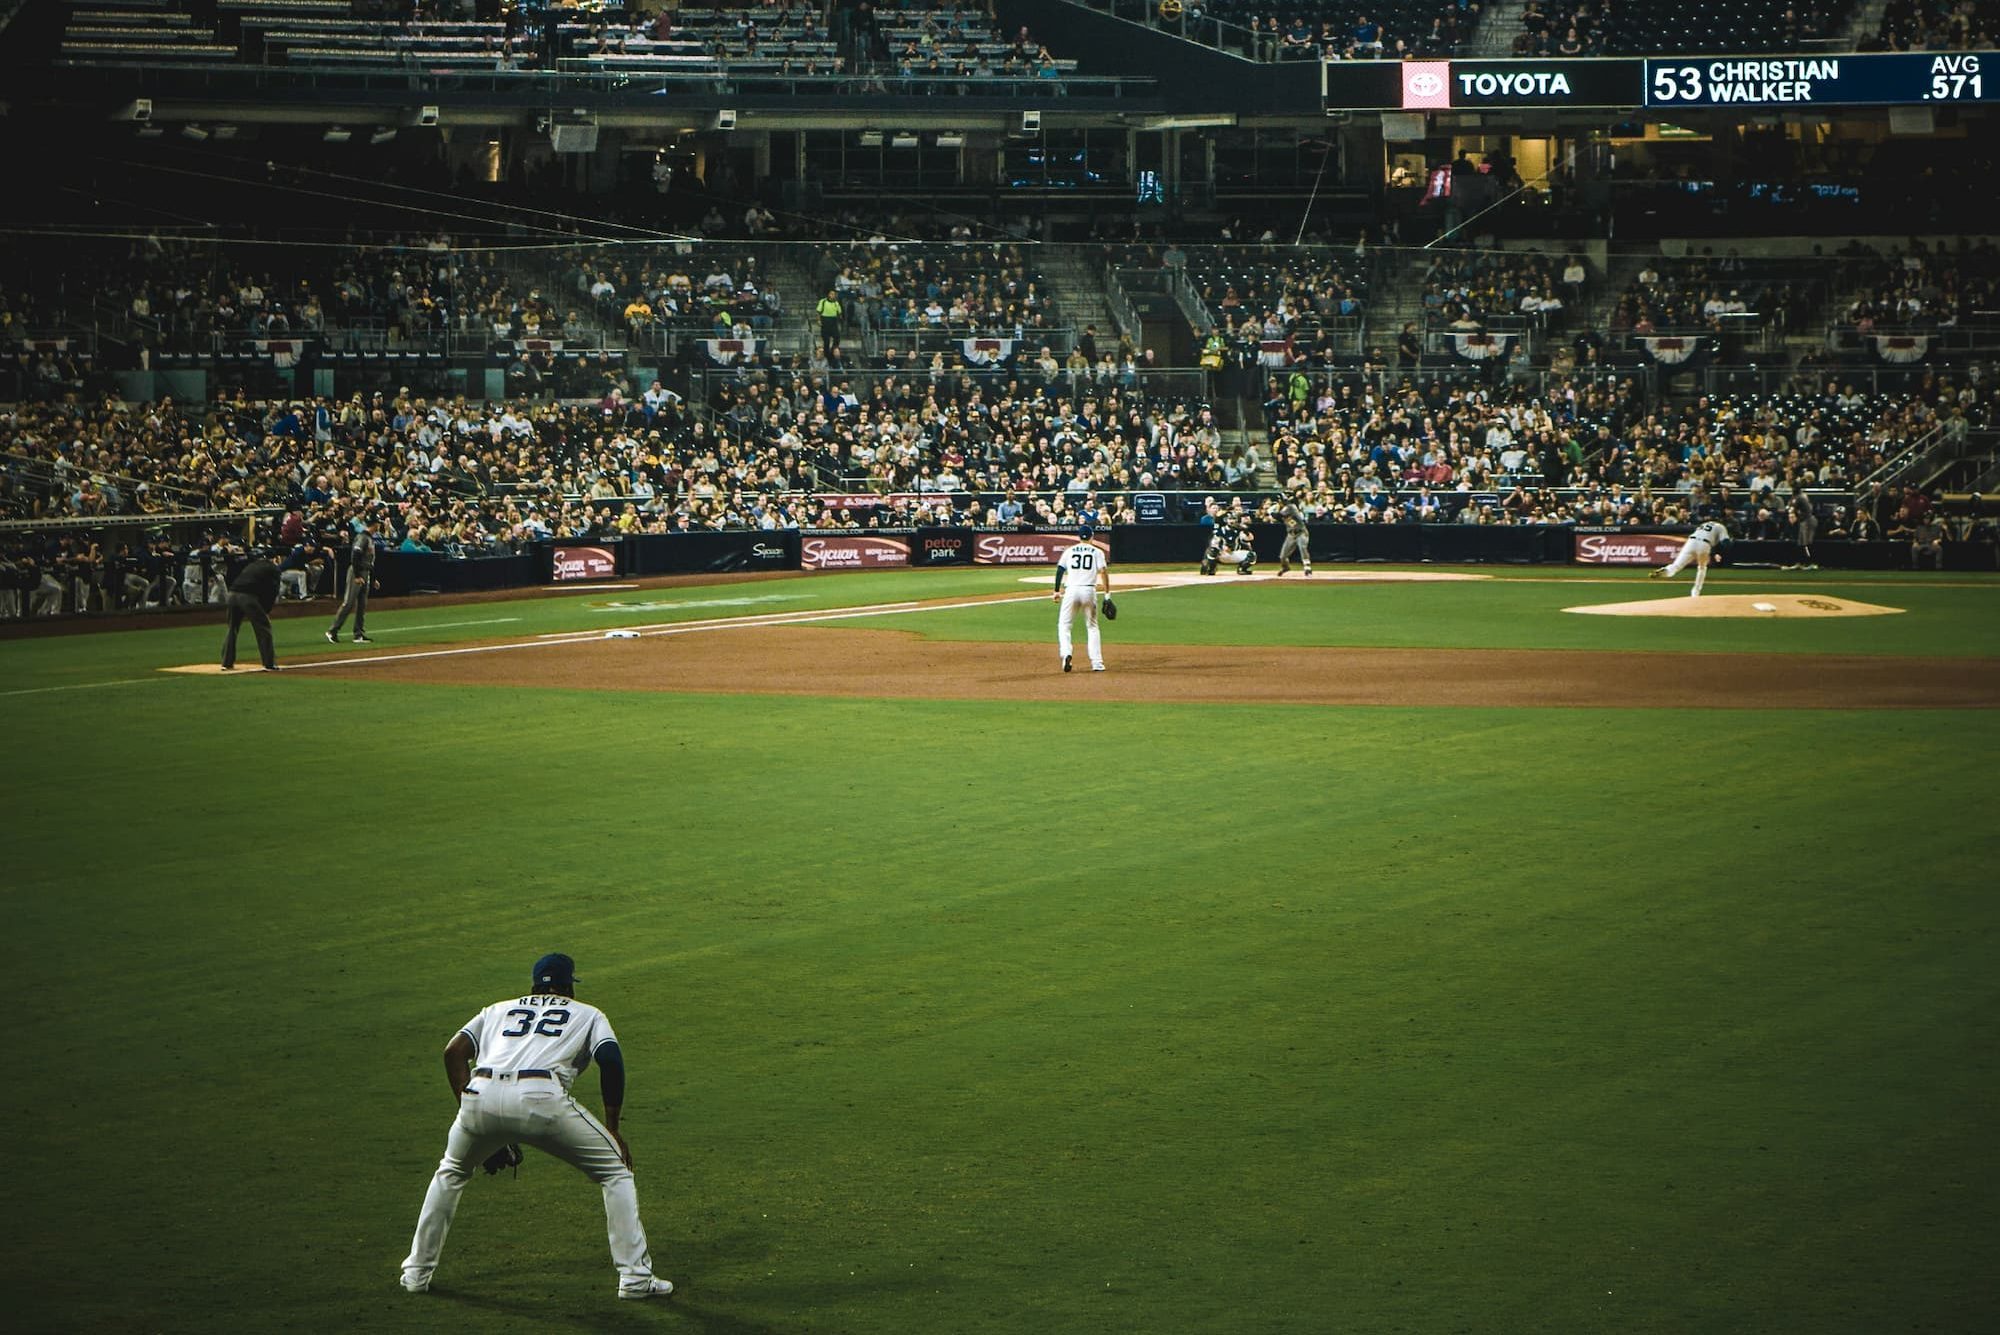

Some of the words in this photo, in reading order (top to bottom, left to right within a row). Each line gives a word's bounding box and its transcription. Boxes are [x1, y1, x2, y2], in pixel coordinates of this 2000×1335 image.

[1708, 60, 1839, 82] CHRISTIAN
[1931, 55, 1980, 74] AVG
[1459, 73, 1571, 96] TOYOTA
[1654, 67, 1702, 101] 53
[1708, 81, 1812, 102] WALKER
[1923, 74, 1982, 99] .571
[801, 540, 860, 567] Sycuan
[924, 537, 962, 552] petco
[931, 548, 956, 559] park
[978, 536, 1047, 563] Sycuan
[1580, 536, 1649, 562] Sycuan
[1071, 554, 1093, 570] 30
[519, 996, 570, 1007] REYES
[502, 1008, 571, 1037] 32
